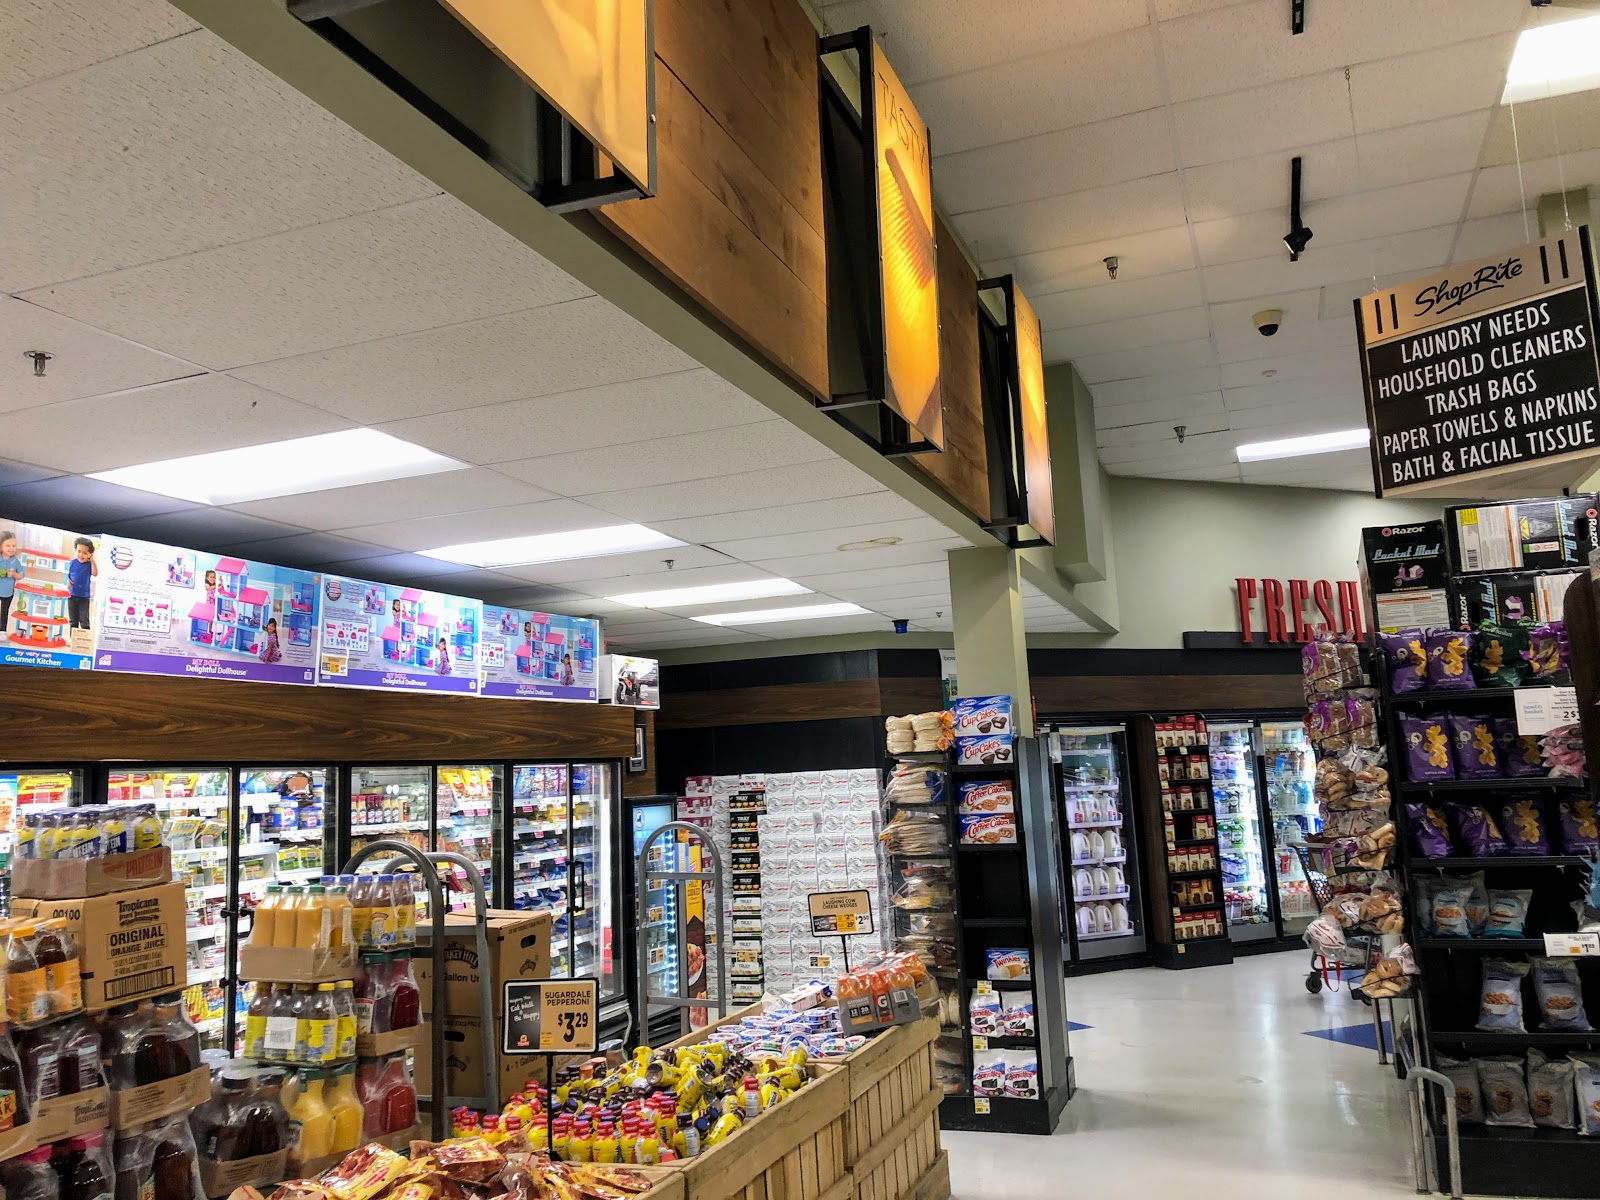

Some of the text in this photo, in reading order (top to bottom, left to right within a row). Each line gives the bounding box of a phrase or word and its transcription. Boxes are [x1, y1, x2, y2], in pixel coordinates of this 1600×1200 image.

[877, 71, 926, 176] TASTY
[1414, 257, 1523, 317] ShopRite
[1401, 302, 1551, 364] LAUNDRY NEEDS
[1378, 324, 1587, 399] HOUSEHOLD CLEANERS
[1425, 369, 1538, 416] TRASH BAGS
[1382, 387, 1598, 456] PAPER TOWELS & NAPKINS
[1391, 420, 1595, 483] BATH & FACIAL TISSUE
[1392, 526, 1425, 535] Razor
[1589, 518, 1599, 548] Razor
[1234, 578, 1365, 643] FRESH
[1460, 594, 1469, 624] Razor
[5, 654, 62, 666] Gourmet Kitchen
[186, 665, 246, 676] Delightful Dollhouse
[961, 708, 998, 728] CupCakes
[964, 740, 1001, 760] CupCakes
[116, 898, 158, 913] Tropicana
[110, 926, 164, 946] ORIGINAL
[111, 939, 165, 957] ORANGE JUICE
[444, 950, 463, 960] RKEY
[993, 956, 1021, 968] Twinkies
[421, 971, 426, 979] 4
[545, 990, 591, 999] SUGARDALE
[546, 998, 590, 1006] PEPPERONI
[878, 995, 888, 1008] G
[523, 1012, 540, 1021] Happy
